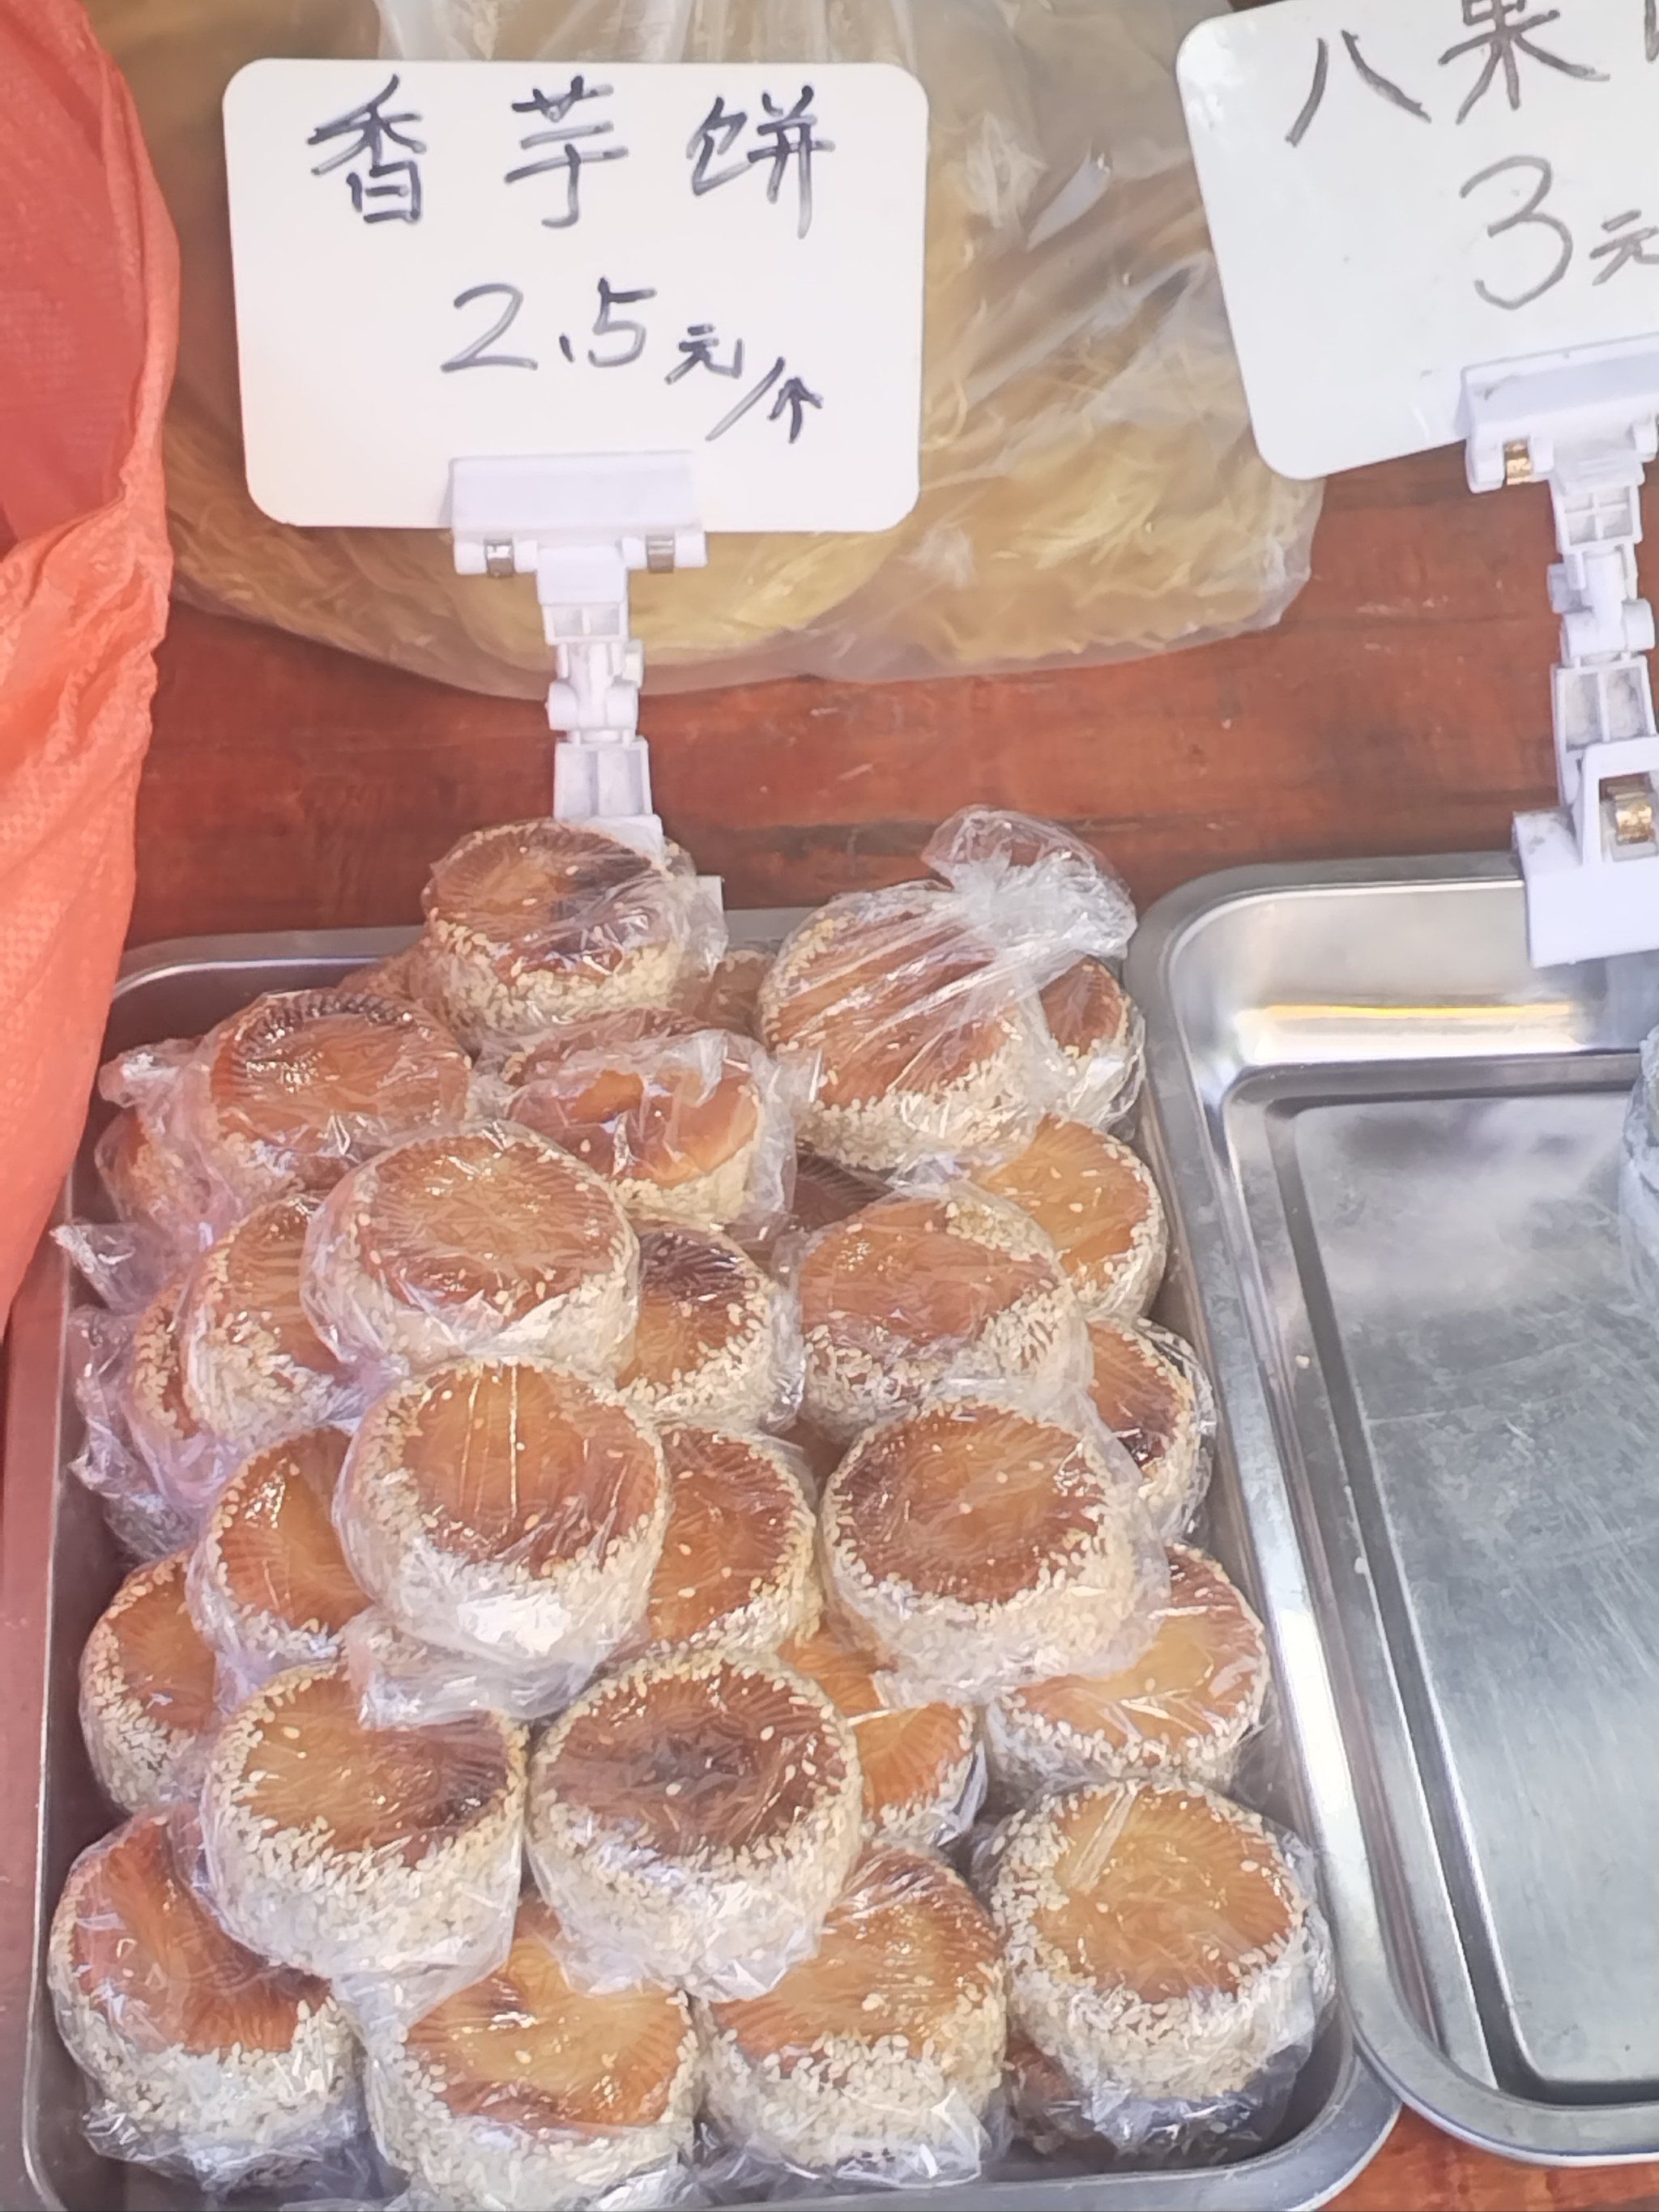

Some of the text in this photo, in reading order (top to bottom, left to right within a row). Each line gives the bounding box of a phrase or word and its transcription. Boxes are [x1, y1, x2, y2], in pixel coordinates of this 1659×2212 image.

[1284, 0, 1659, 147] 八果
[307, 74, 836, 240] 香芋饼
